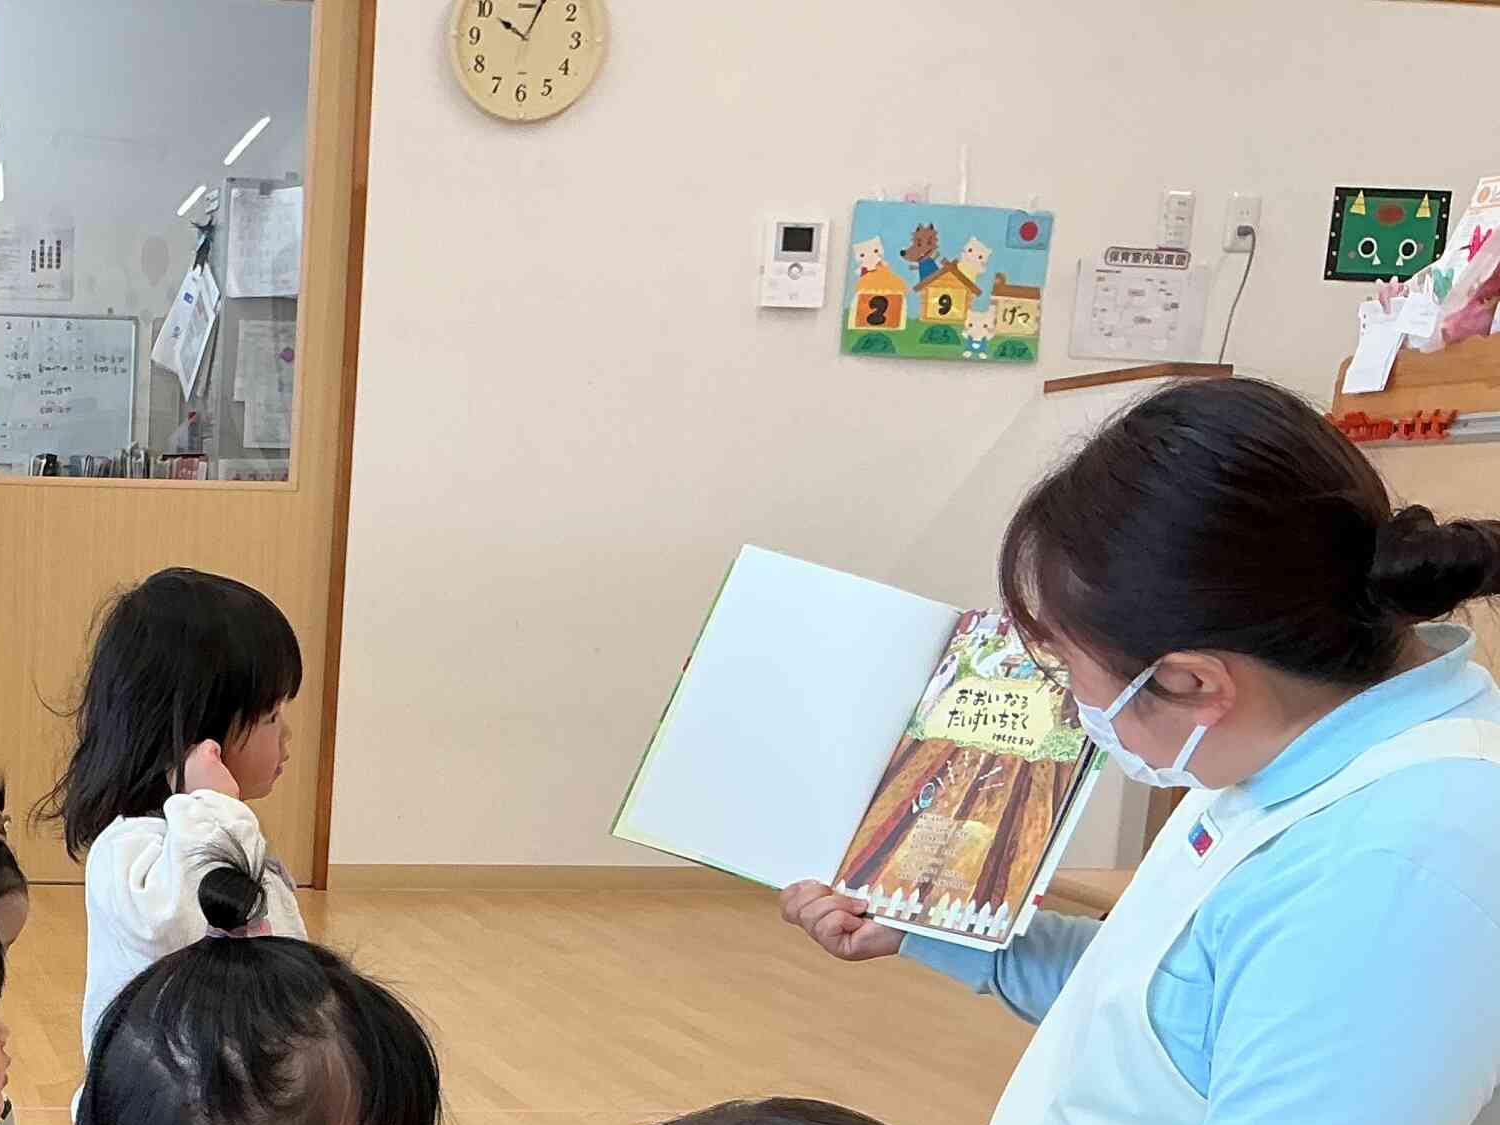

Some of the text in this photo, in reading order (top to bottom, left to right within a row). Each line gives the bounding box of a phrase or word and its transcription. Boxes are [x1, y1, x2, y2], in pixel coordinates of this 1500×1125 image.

[477, 0, 493, 18] 10
[565, 3, 577, 22] 2
[469, 26, 481, 45] 9
[569, 31, 582, 50] 3
[473, 54, 485, 73] 8
[558, 57, 570, 76] 4
[491, 76, 502, 94] 7
[515, 83, 527, 102] 6
[540, 78, 553, 96] 5
[867, 295, 889, 326] 2
[938, 294, 953, 315] 9
[1002, 305, 1031, 325] げつ
[955, 688, 1029, 710] おおいなる
[947, 707, 1030, 733] だいずいちぞく
